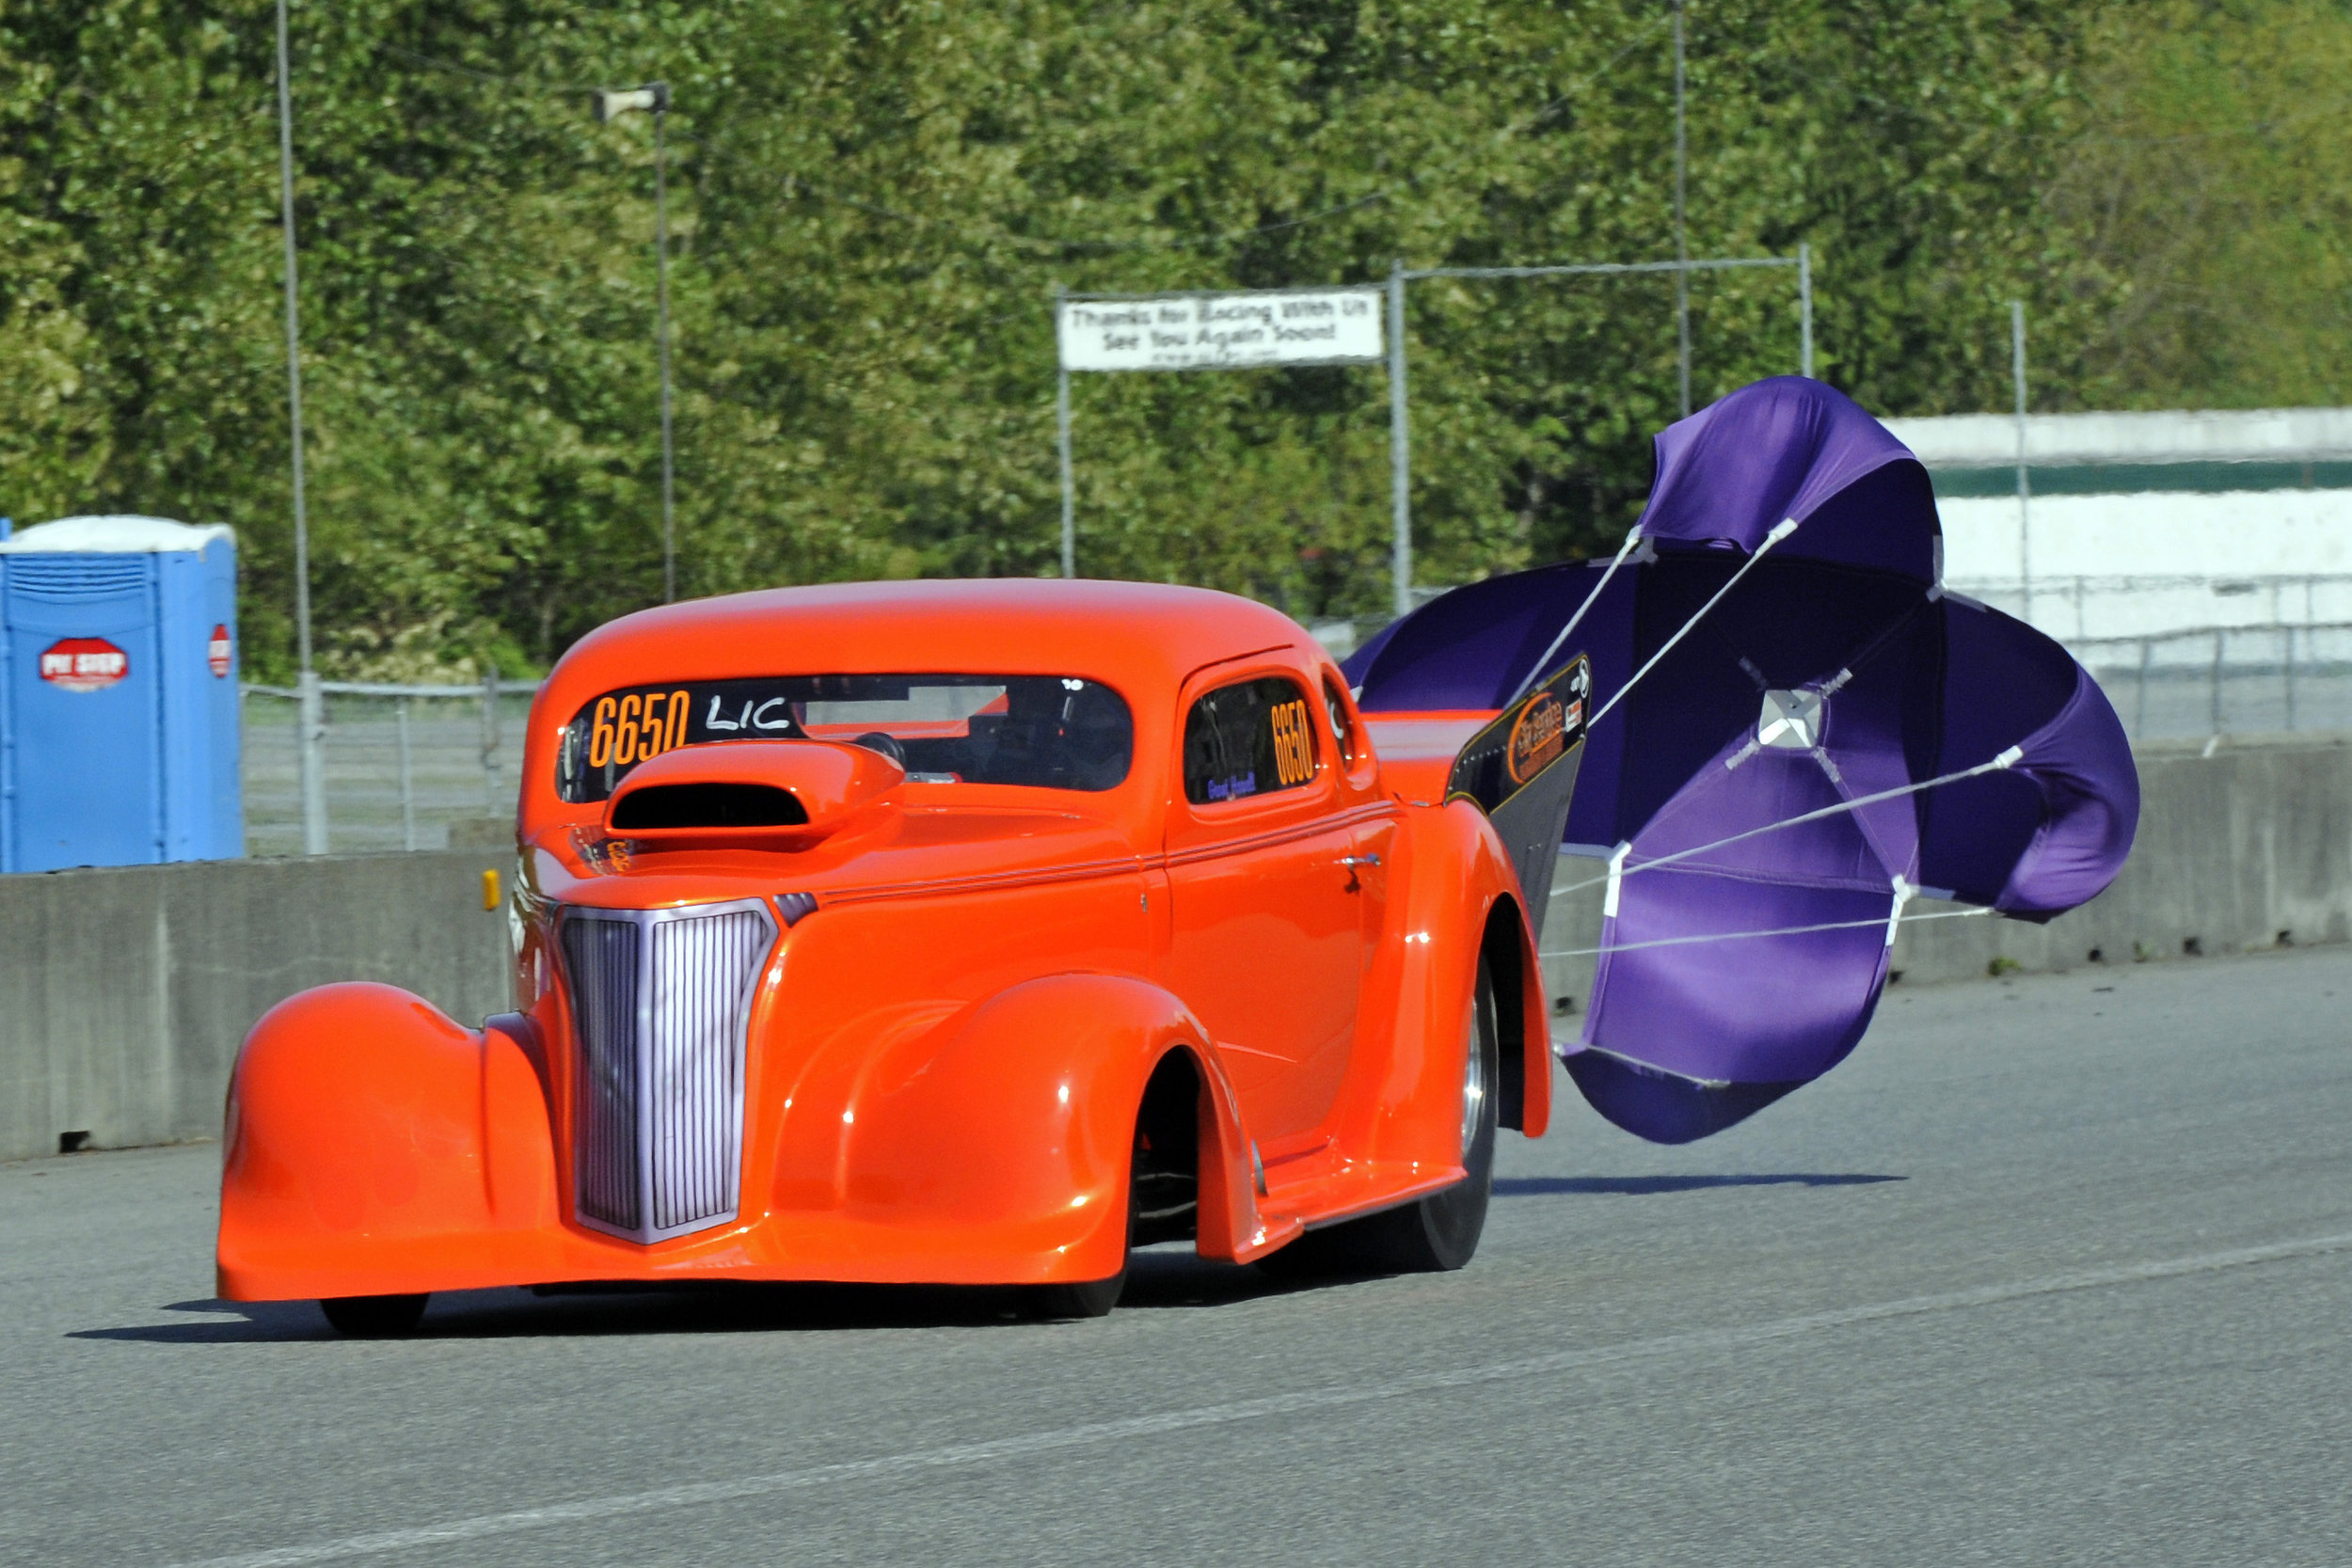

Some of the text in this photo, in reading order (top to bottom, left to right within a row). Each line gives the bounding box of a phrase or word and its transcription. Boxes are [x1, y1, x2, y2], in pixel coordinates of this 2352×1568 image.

[1073, 309, 1152, 327] Thanks
[1197, 300, 1273, 325] Racing
[1281, 300, 1334, 319] With
[1103, 332, 1140, 351] See
[1150, 330, 1188, 348] You
[1195, 327, 1265, 352] Again
[589, 689, 691, 768] 6650
[706, 694, 790, 731] LIC
[1271, 699, 1313, 785] 6650
